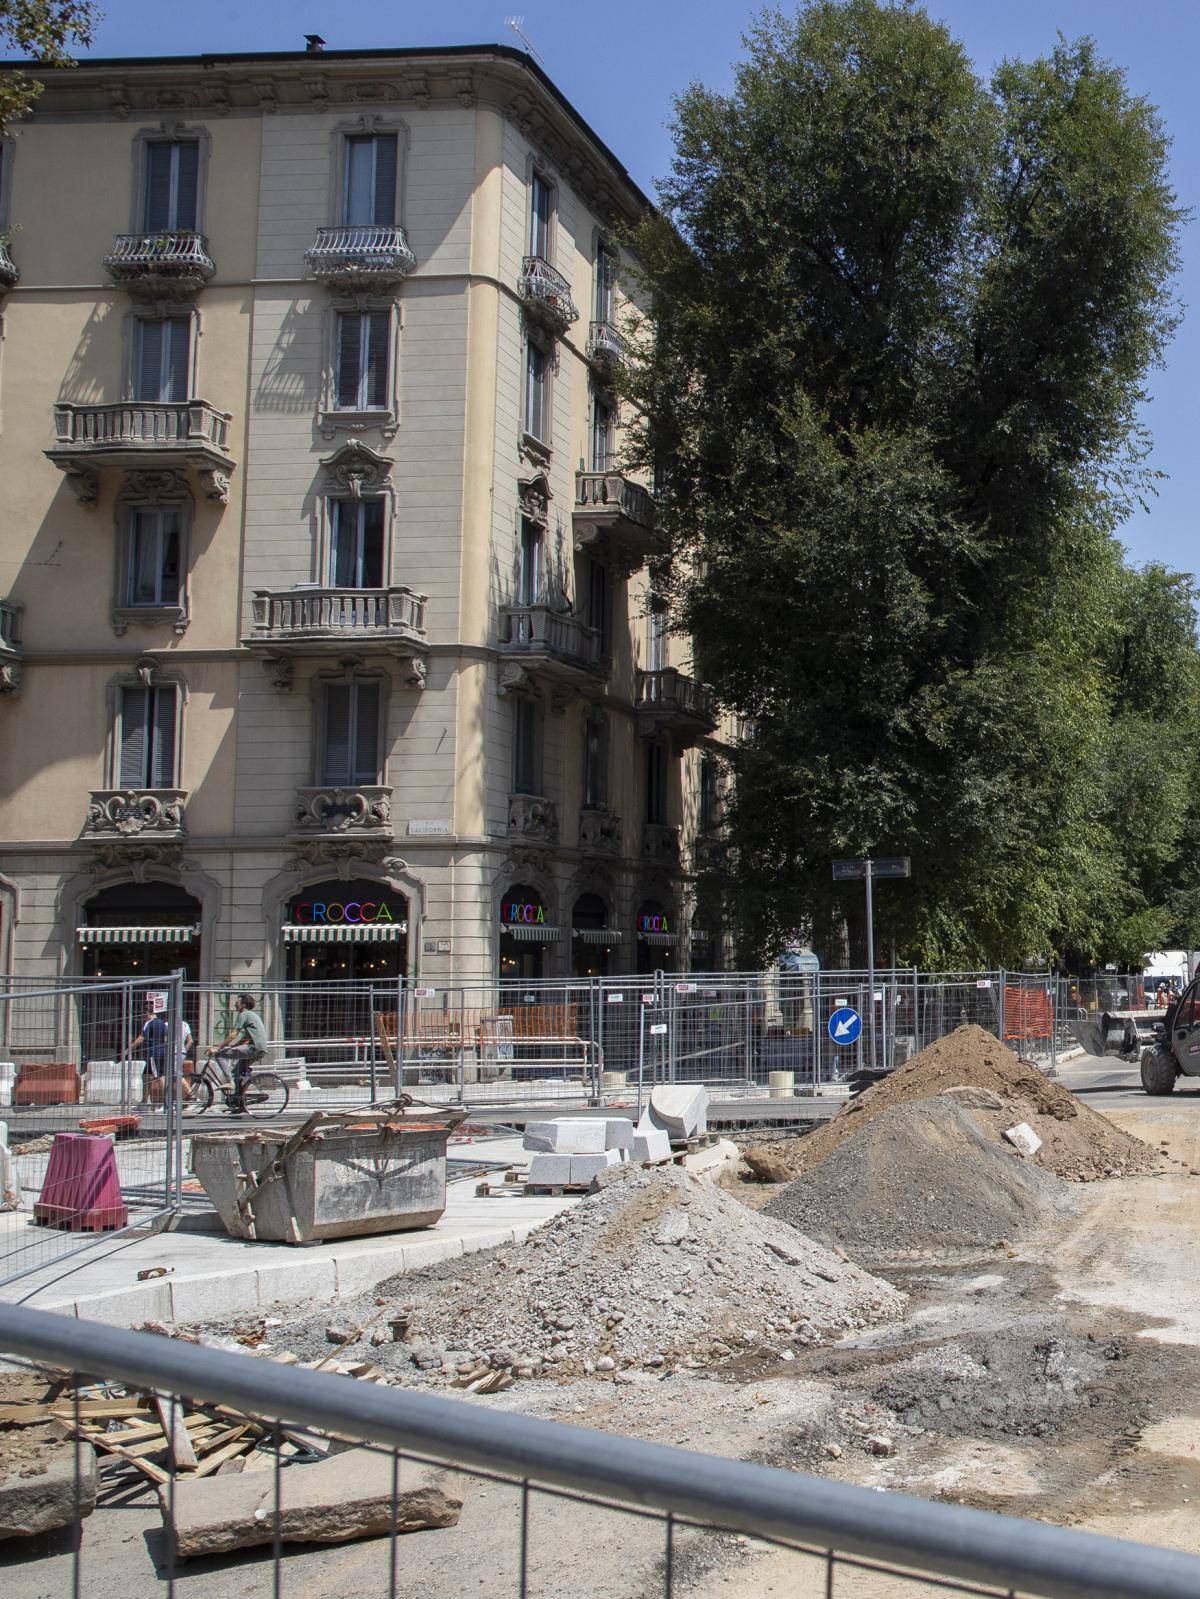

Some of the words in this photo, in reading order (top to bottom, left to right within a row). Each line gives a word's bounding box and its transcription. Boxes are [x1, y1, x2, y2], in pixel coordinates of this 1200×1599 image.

[296, 902, 393, 922] CROCCA
[503, 903, 544, 924] CROCCA
[637, 916, 668, 932] CROCCA
